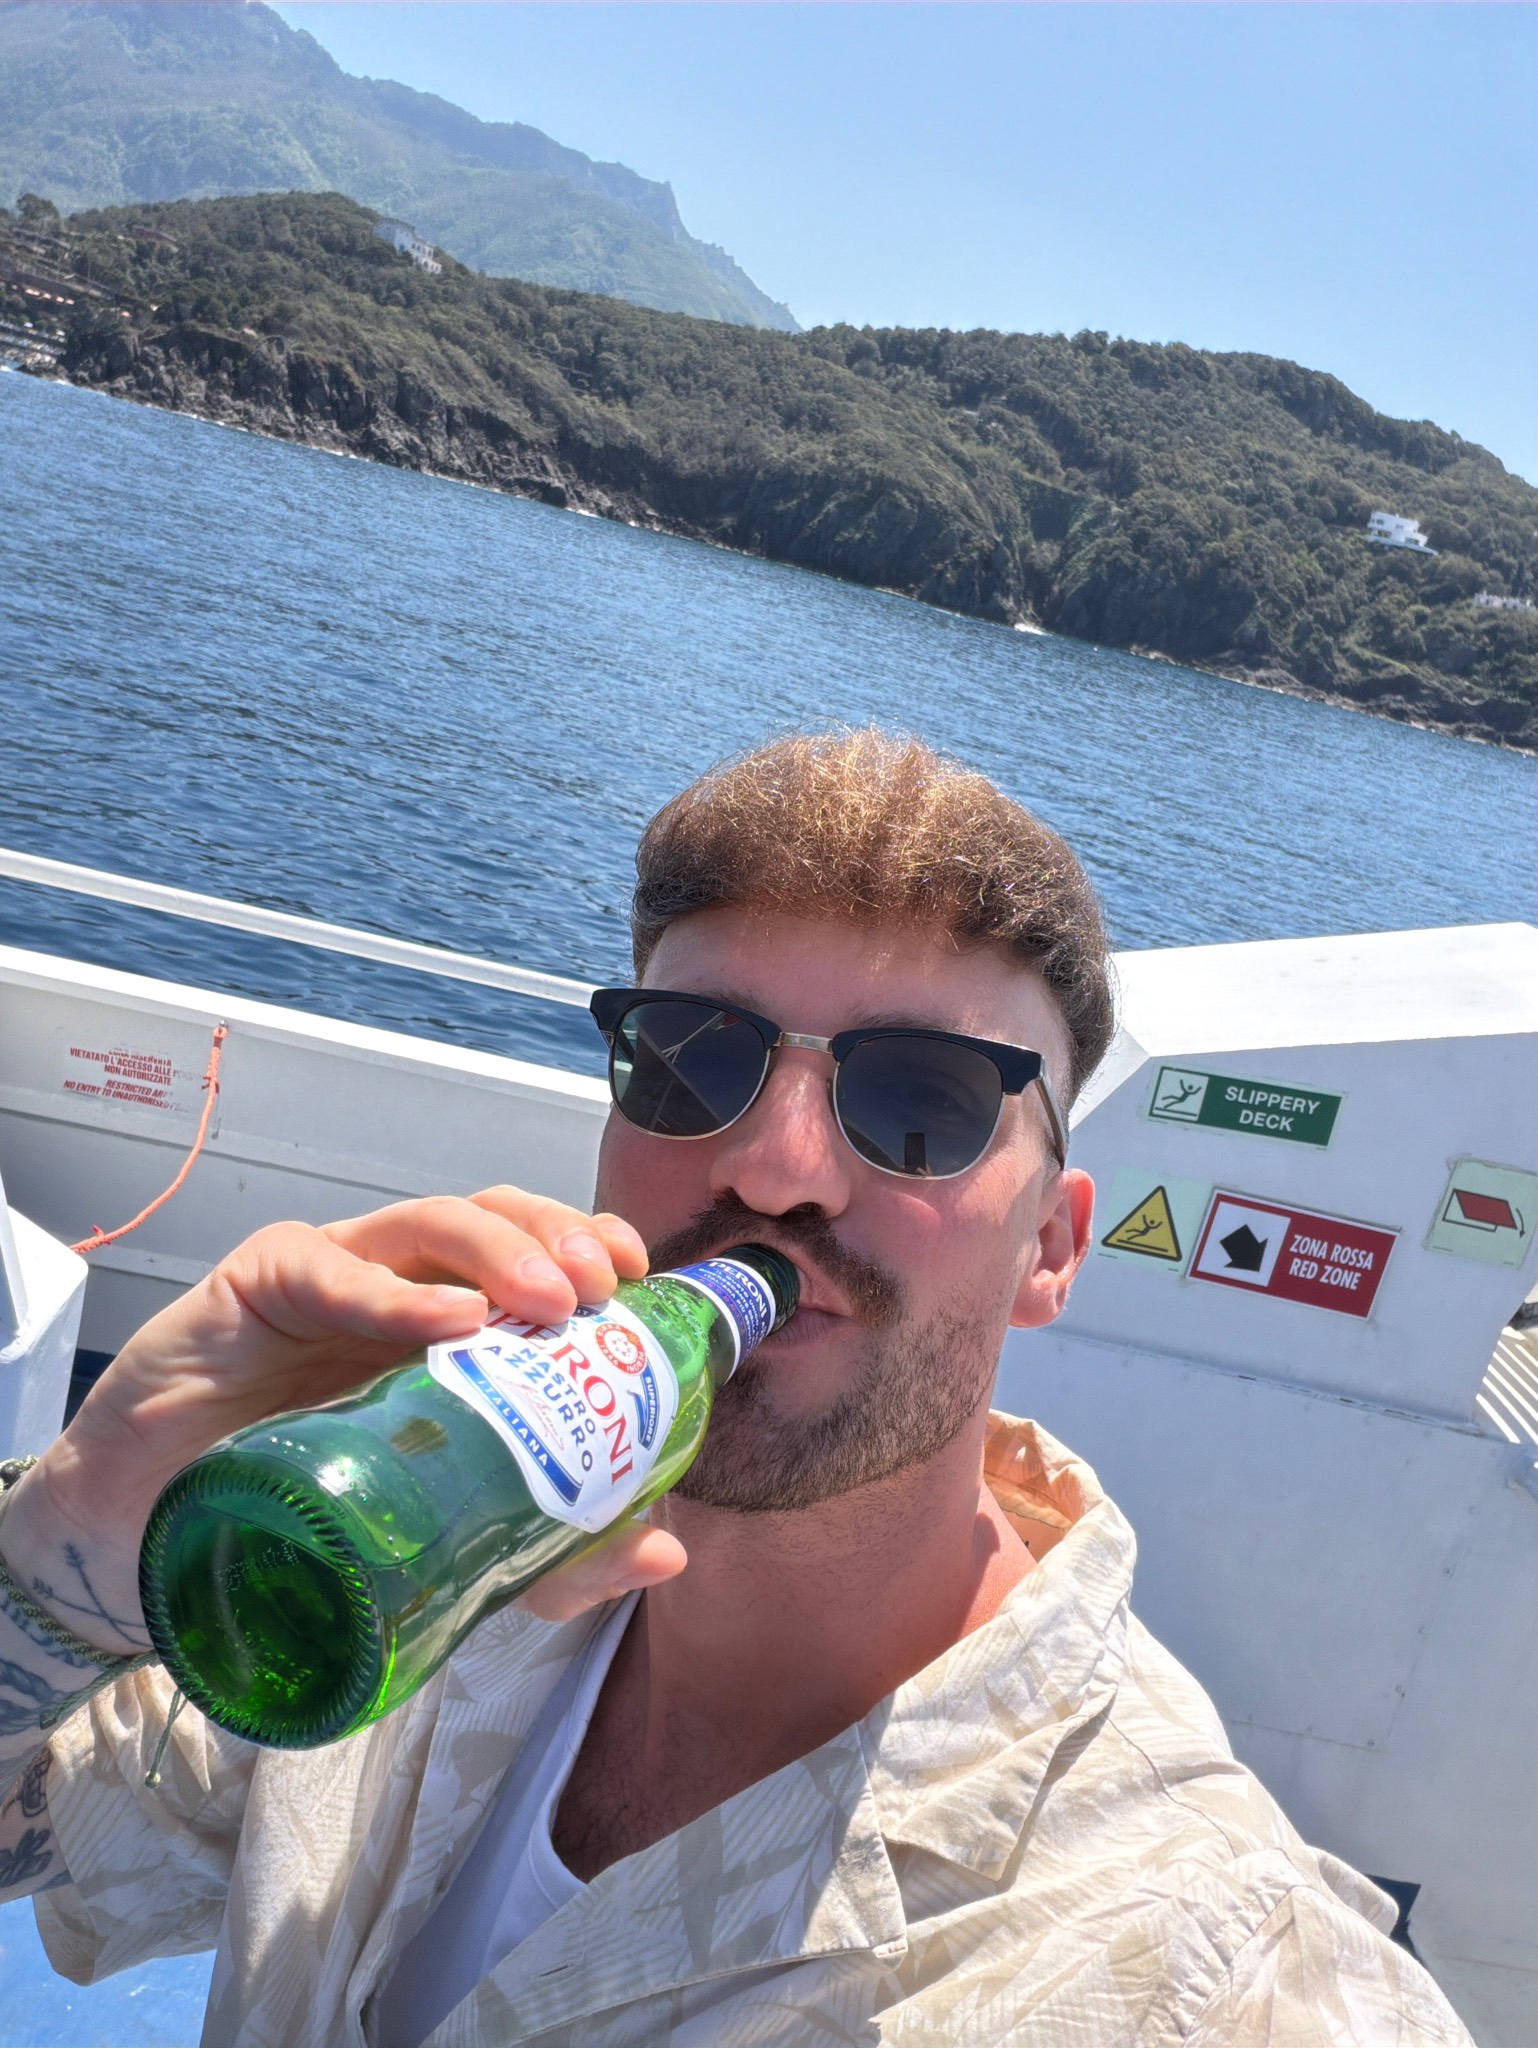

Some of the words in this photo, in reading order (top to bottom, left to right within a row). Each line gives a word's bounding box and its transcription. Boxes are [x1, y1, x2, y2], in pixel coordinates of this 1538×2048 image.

[70, 1047, 109, 1063] VIETATATO
[111, 1055, 152, 1072] L'ACCESSO
[154, 1065, 171, 1077] ALLE
[104, 1064, 120, 1075] NON
[122, 1069, 172, 1086] AUTORIZZATE
[63, 1080, 76, 1089] NO
[76, 1082, 101, 1095] ENTRY
[102, 1087, 112, 1097] TO
[105, 1080, 152, 1096] RESTRICTED
[1225, 1086, 1320, 1115] SLIPPERY
[1239, 1109, 1294, 1132] DECK
[1289, 1234, 1327, 1261] ZONA
[1331, 1242, 1374, 1270] ROSSA
[709, 1262, 767, 1318] PERONI
[1289, 1258, 1319, 1279] RED
[1320, 1265, 1361, 1291] ZONE
[519, 1347, 597, 1435] NASTRO
[477, 1379, 548, 1467] ITALIANA
[482, 1345, 593, 1473] AZZURRO
[644, 1376, 657, 1443] SUPERIORE
